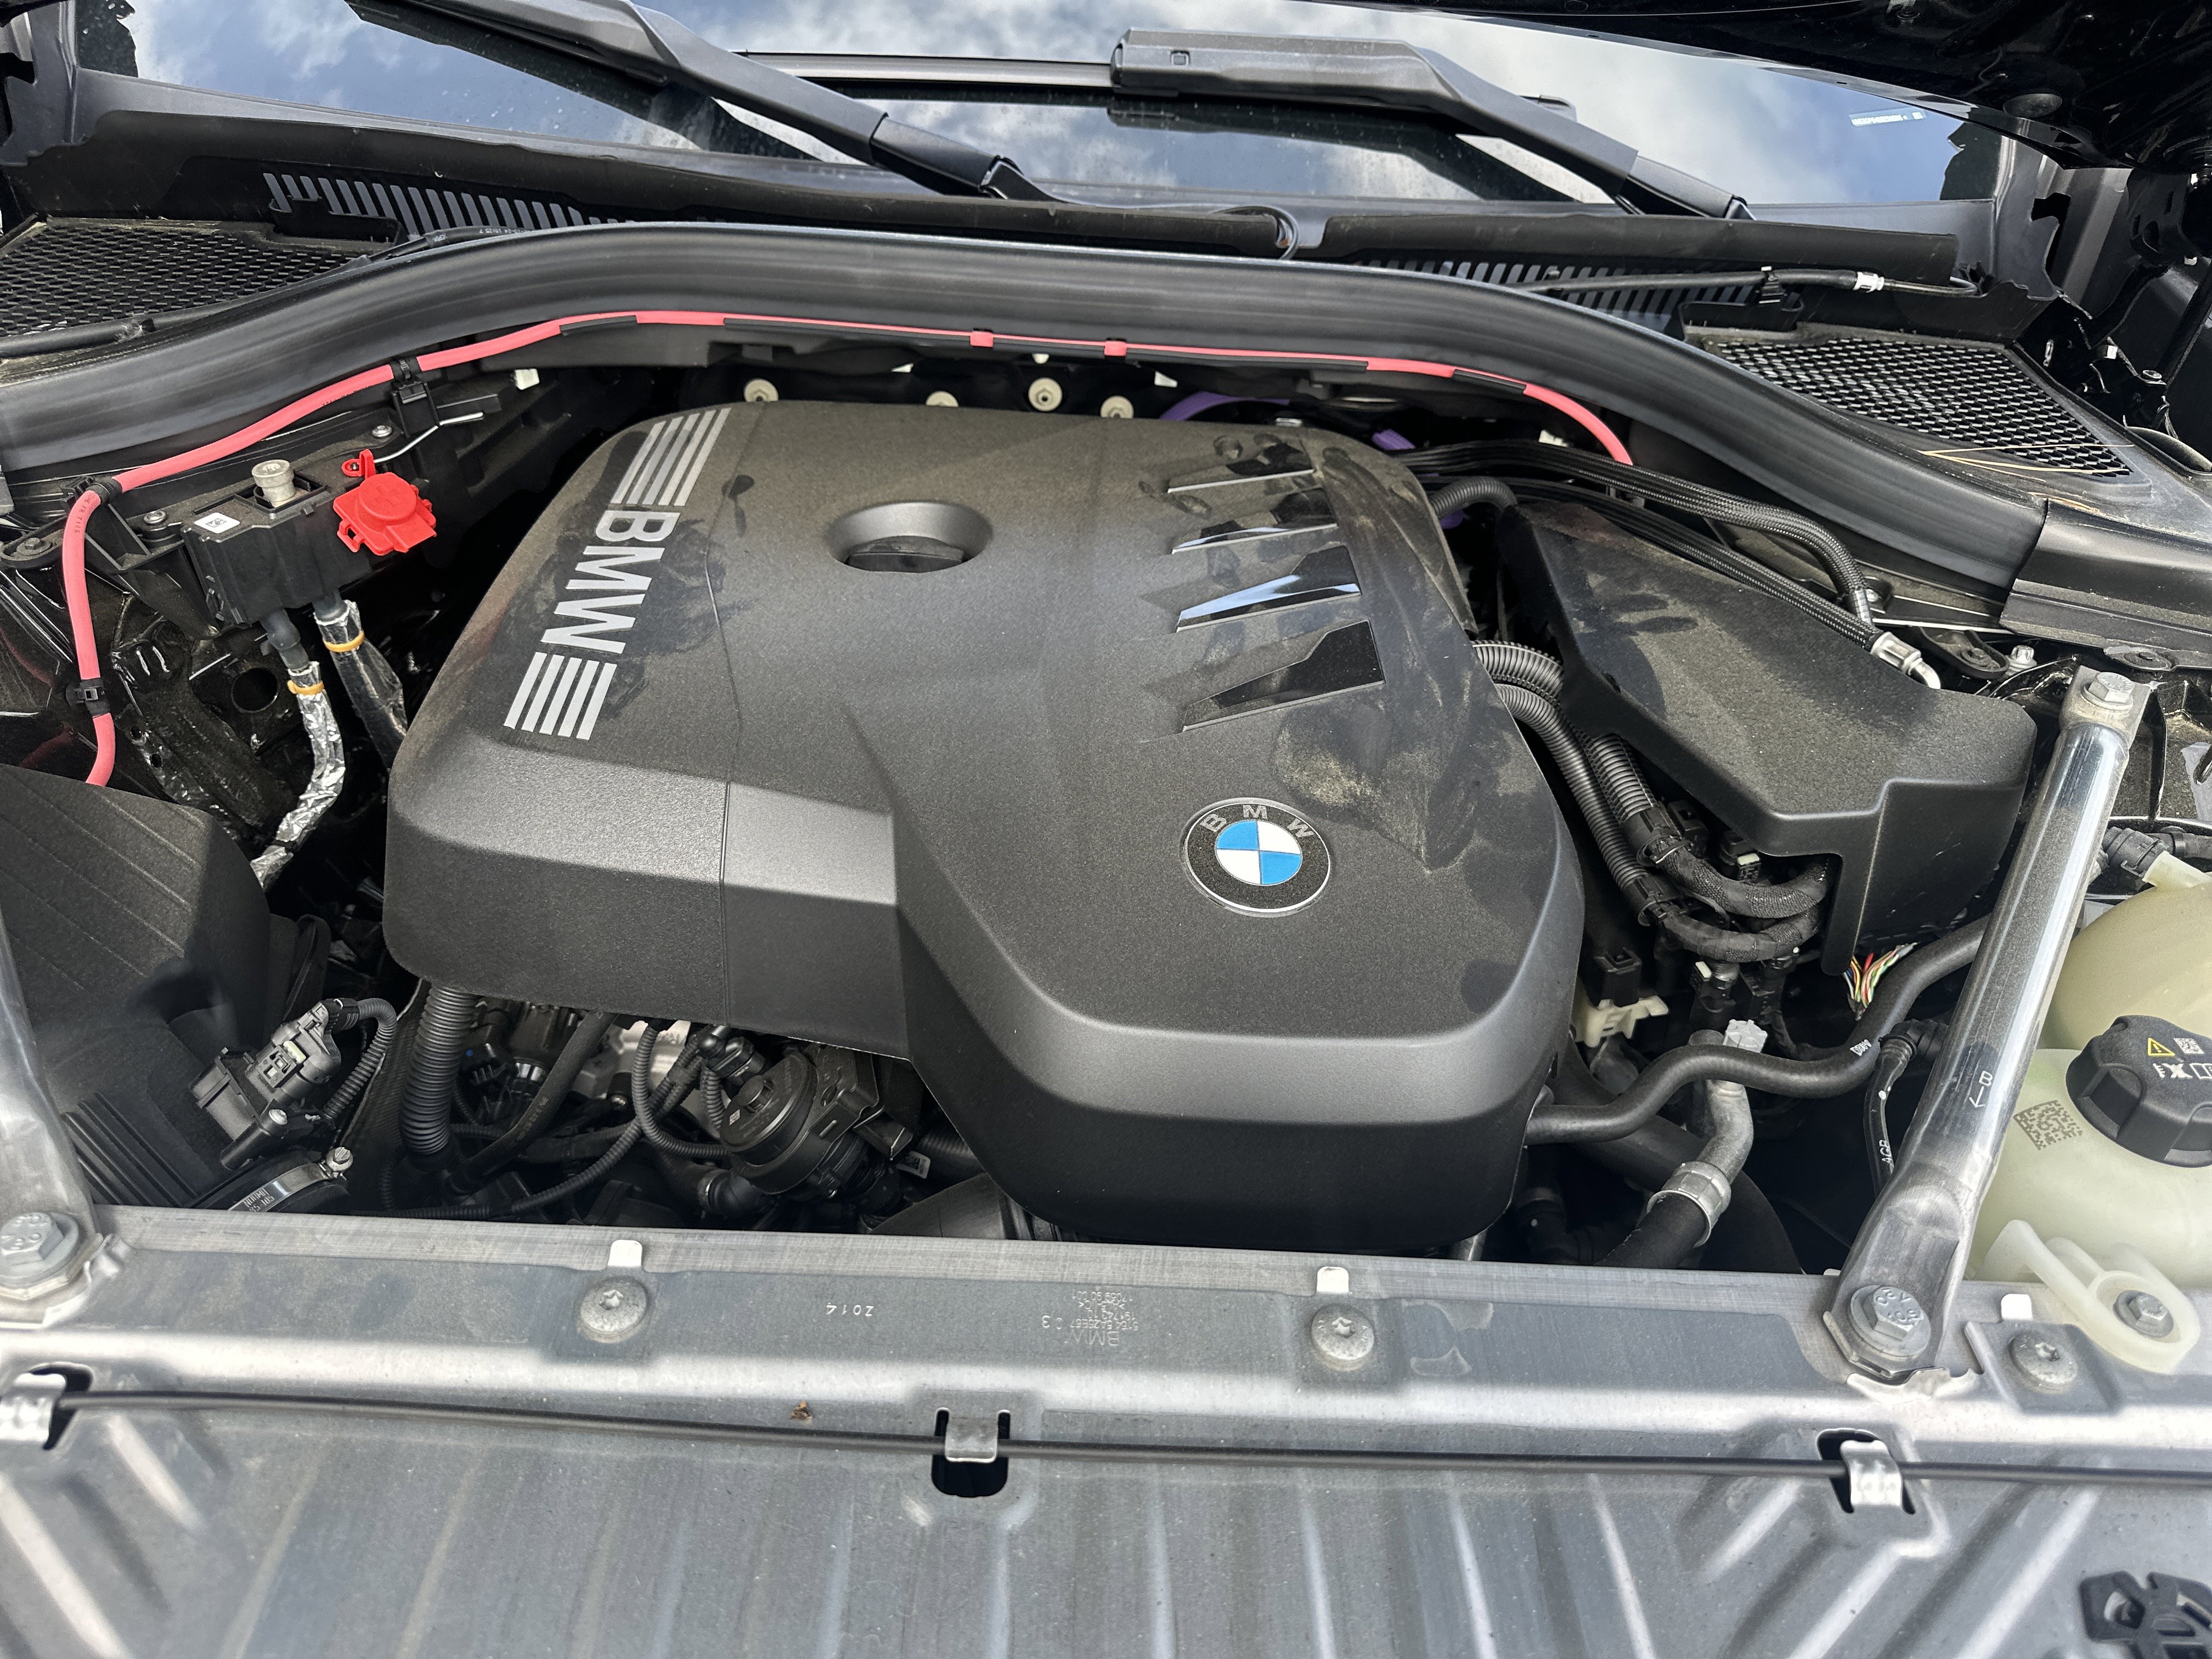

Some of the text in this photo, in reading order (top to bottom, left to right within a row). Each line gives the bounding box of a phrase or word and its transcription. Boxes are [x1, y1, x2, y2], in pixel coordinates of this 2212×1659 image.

[540, 510, 681, 654] BMW
[1200, 804, 1314, 838] BMW
[1979, 1071, 1993, 1086] B
[1064, 1329, 1120, 1346] BMW
